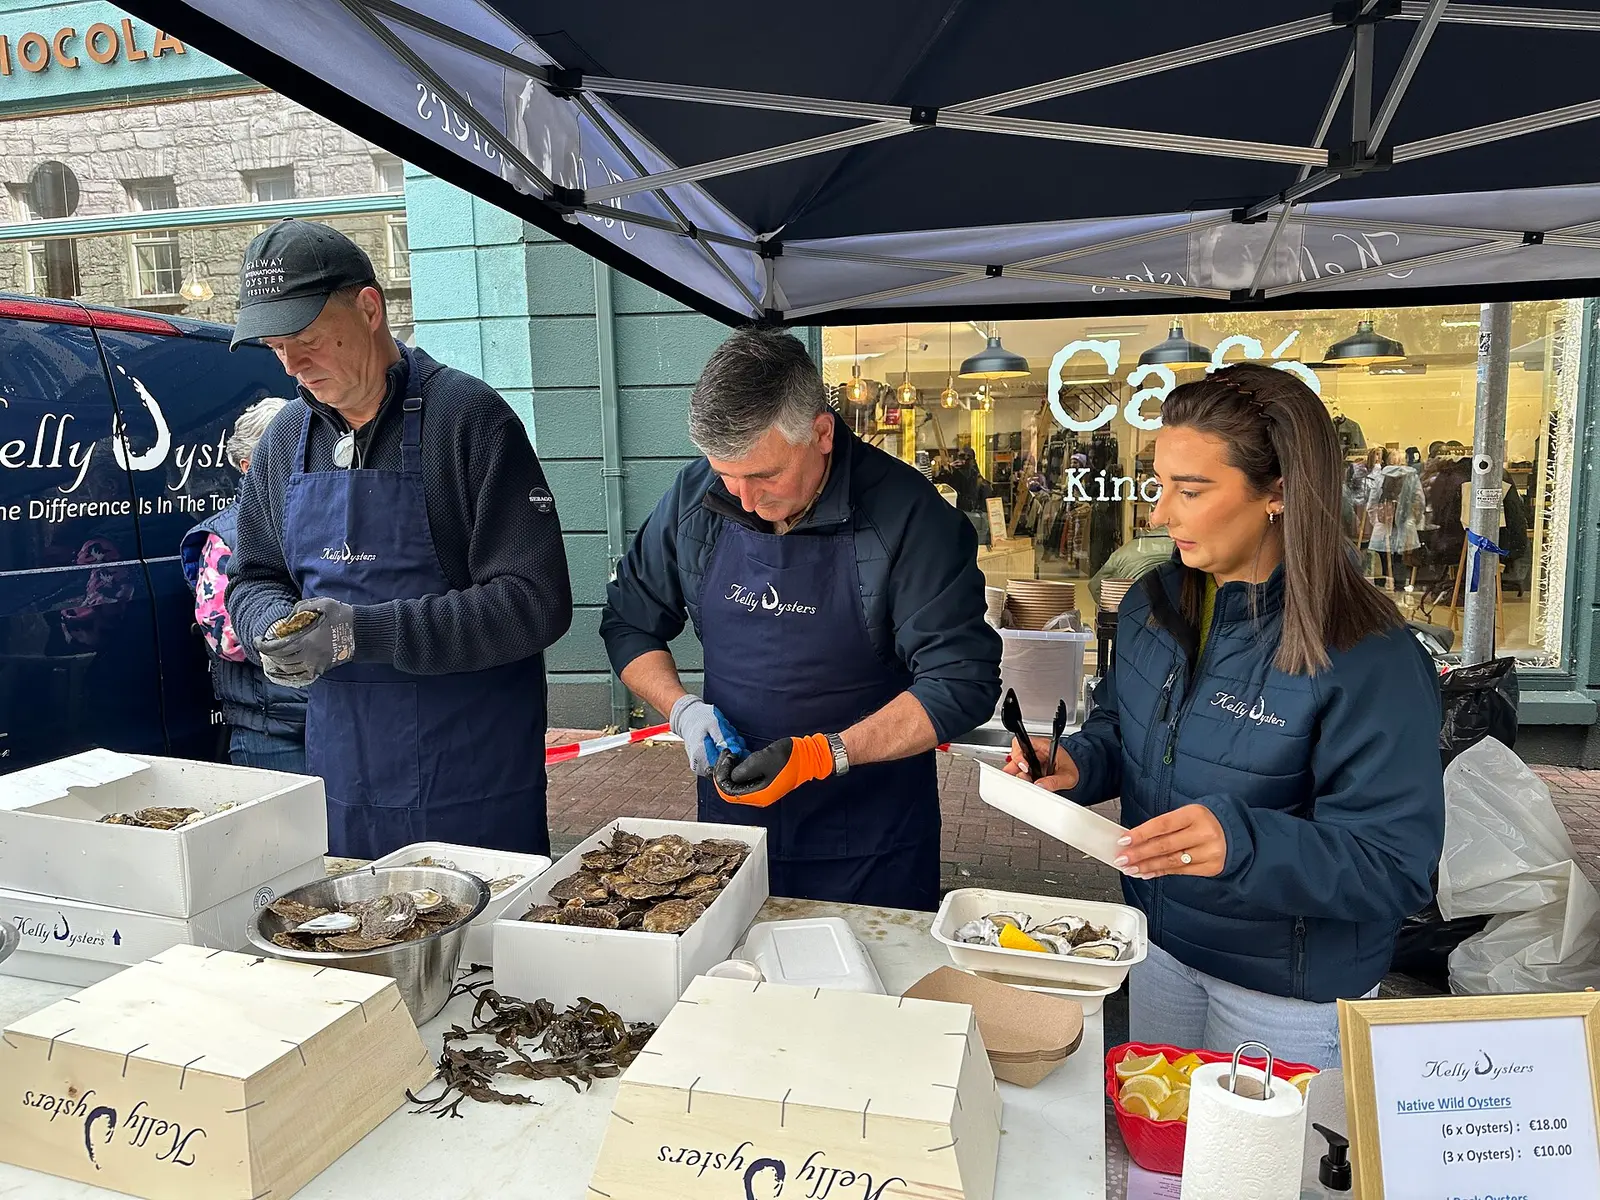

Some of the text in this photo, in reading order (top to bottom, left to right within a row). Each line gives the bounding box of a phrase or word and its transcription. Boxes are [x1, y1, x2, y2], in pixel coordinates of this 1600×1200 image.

[0, 18, 187, 76] OCOLA
[246, 257, 284, 270] GALWAY
[245, 275, 284, 288] OYSTER
[247, 286, 281, 298] FESTIVAL
[0, 397, 96, 493] elly
[29, 495, 130, 522] Difference
[139, 497, 153, 515] Is
[157, 496, 172, 513] In
[177, 495, 205, 512] The
[320, 547, 342, 564] Kelly
[724, 582, 817, 616] Kelly Oysters
[1210, 691, 1286, 727] Kelly Oysters
[12, 911, 105, 948] Kelly Oysters
[1421, 1049, 1534, 1082] Kelly Oysters
[1397, 1096, 1512, 1112] Native Wild Oysters
[22, 1090, 207, 1170] Kelly Oysters
[1441, 1123, 1453, 1138] (6
[1456, 1127, 1463, 1136] x
[1465, 1120, 1514, 1137] Oysters)
[1529, 1118, 1568, 1131] €18.00
[1442, 1150, 1454, 1165] (3
[1457, 1154, 1464, 1162] x
[1466, 1147, 1515, 1163] Oysters)
[1533, 1144, 1572, 1158] €10.00
